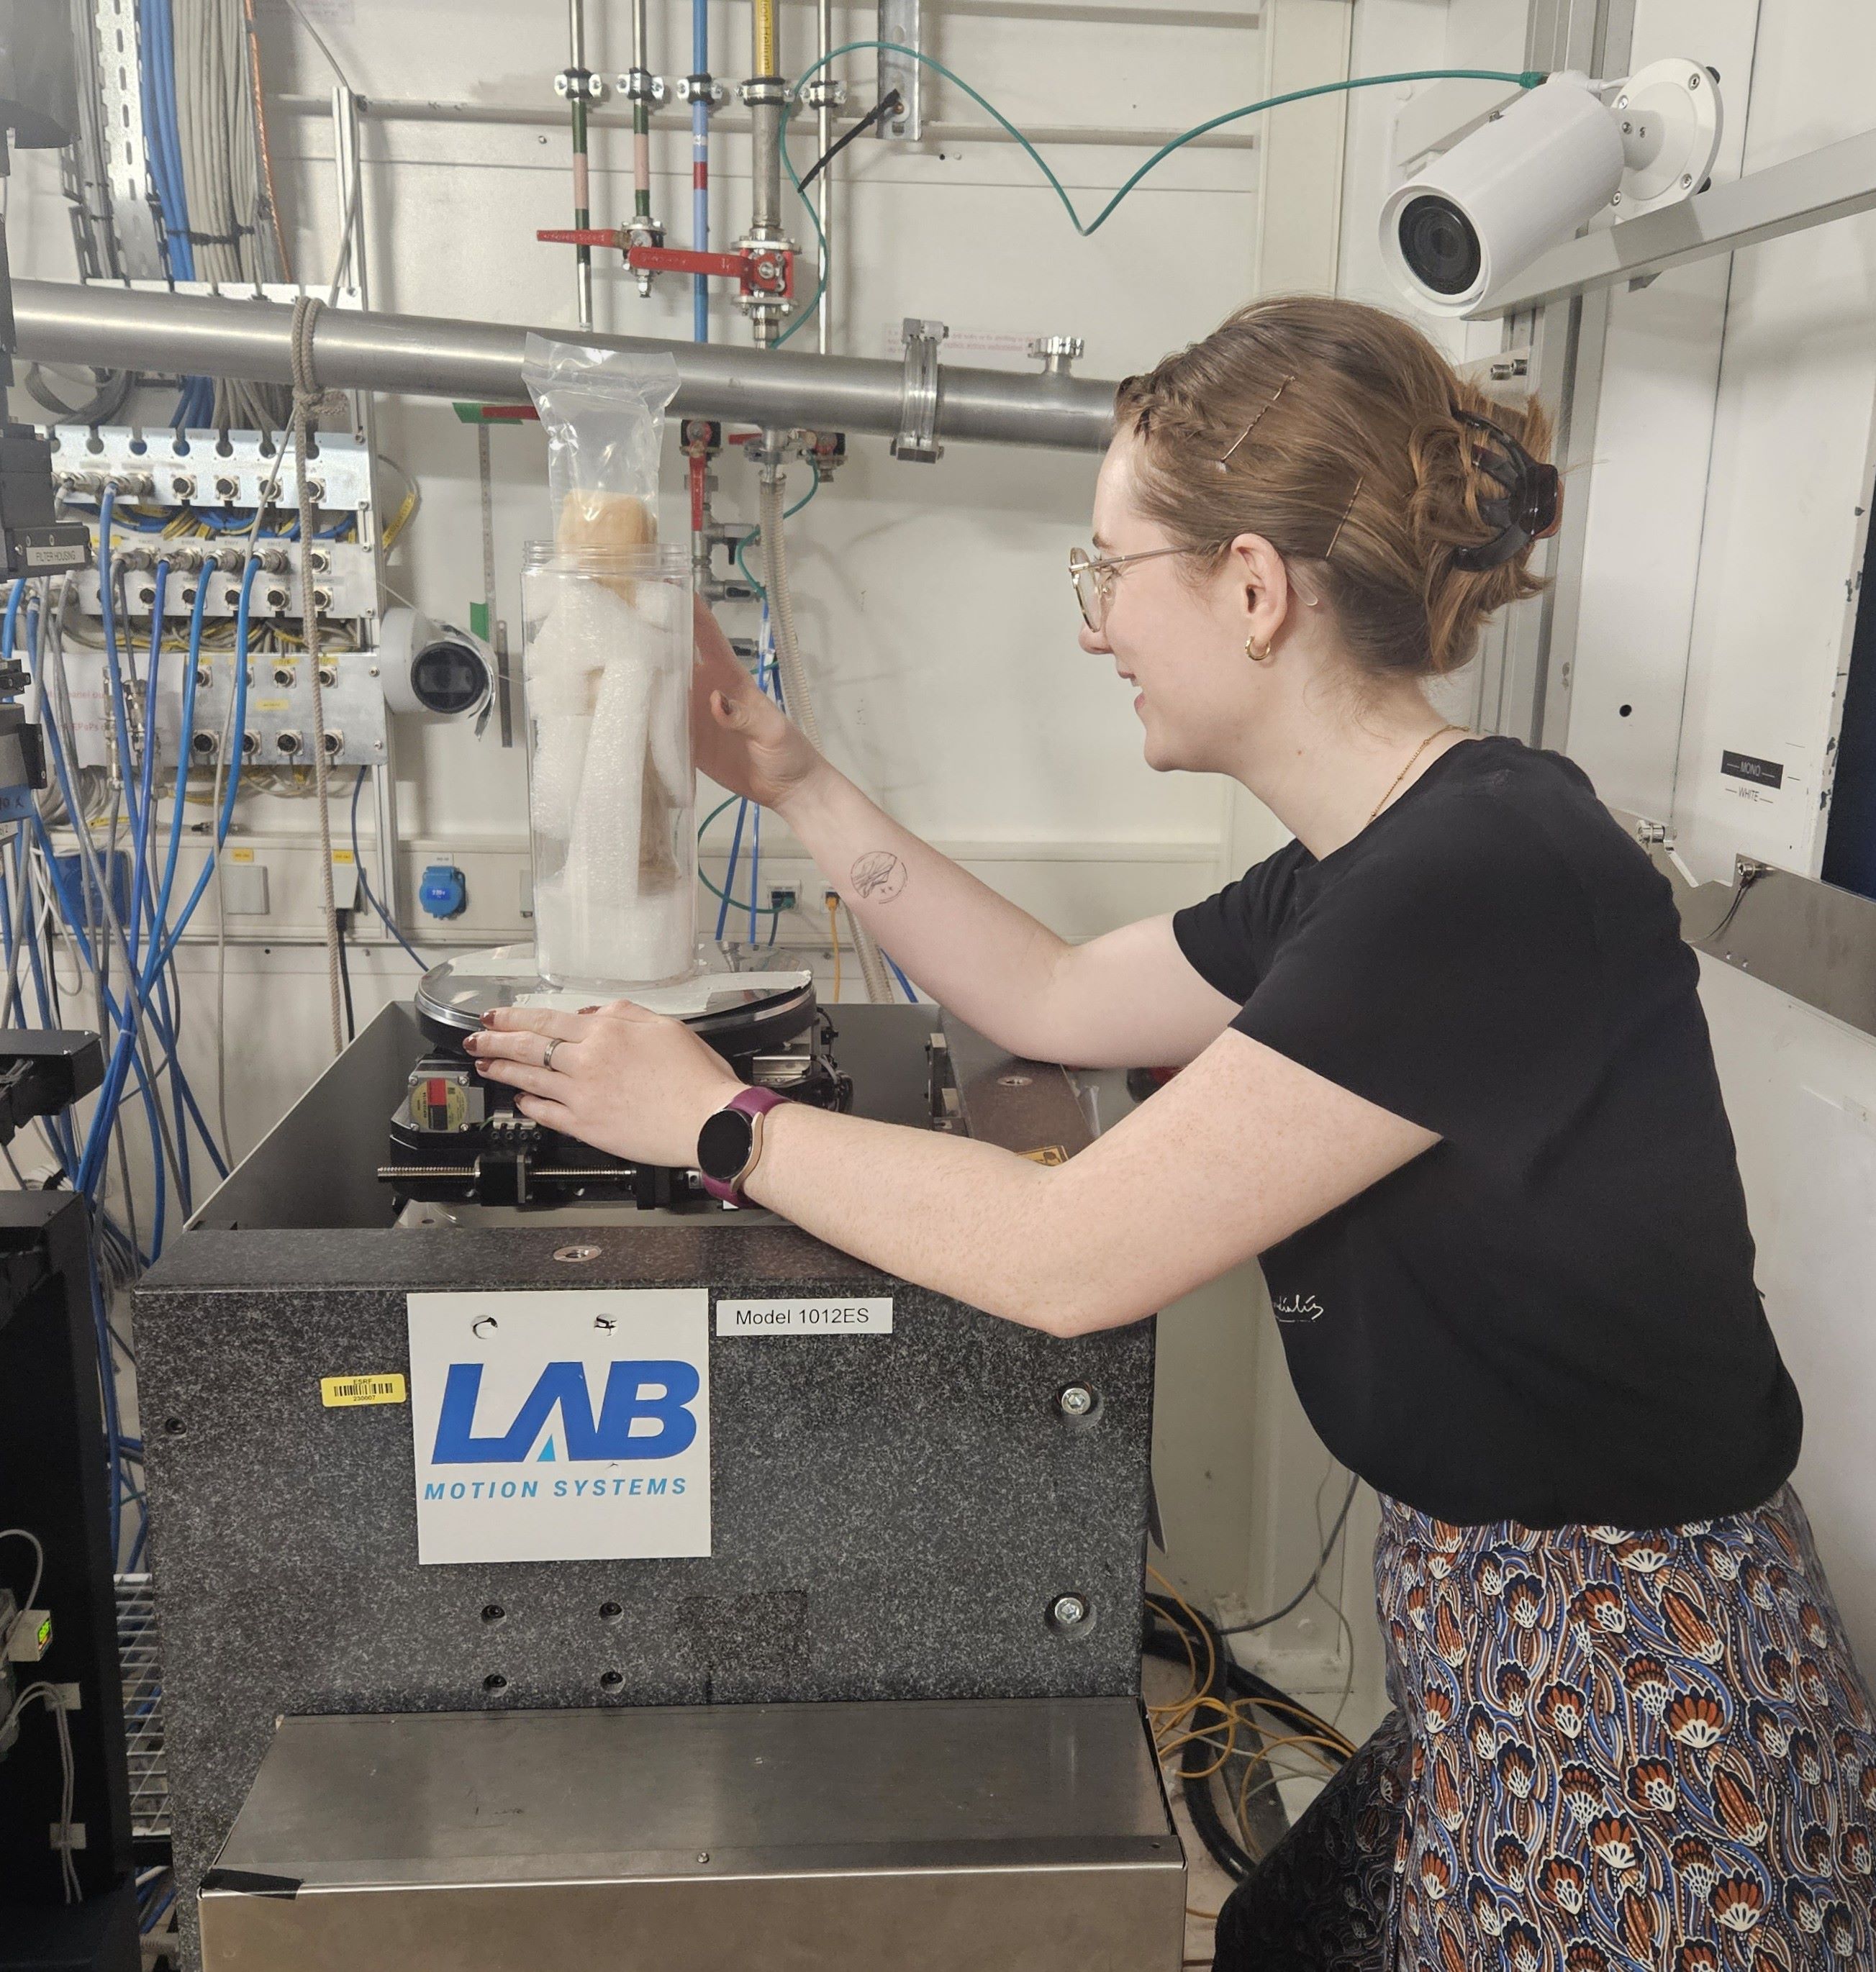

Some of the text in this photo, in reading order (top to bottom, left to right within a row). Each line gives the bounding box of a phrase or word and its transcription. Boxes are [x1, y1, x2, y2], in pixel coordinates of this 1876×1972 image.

[36, 550, 76, 563] FILTER HOUSING
[1740, 761, 1762, 777] MONO
[1739, 786, 1760, 802] WHITE
[736, 1308, 869, 1324] Model 1012ES
[431, 1360, 700, 1465] LAB
[425, 1478, 686, 1499] MOTION SYSTEMS
